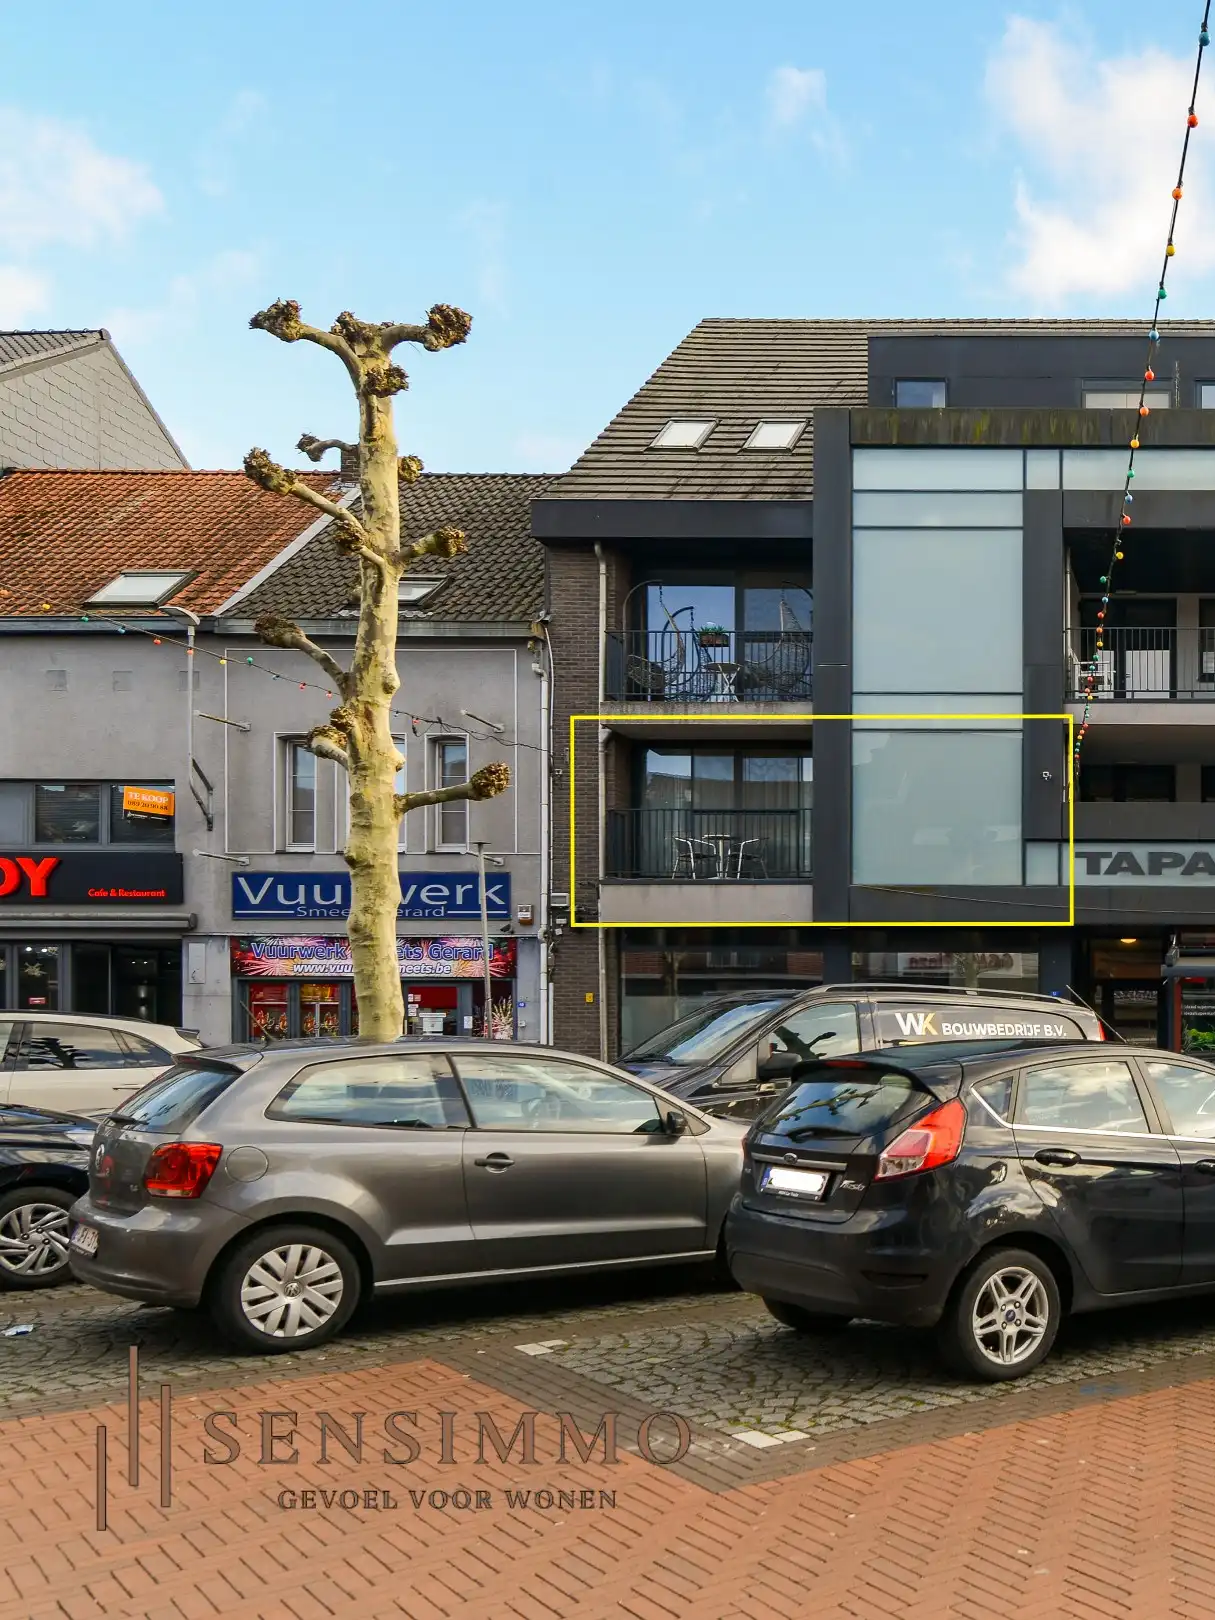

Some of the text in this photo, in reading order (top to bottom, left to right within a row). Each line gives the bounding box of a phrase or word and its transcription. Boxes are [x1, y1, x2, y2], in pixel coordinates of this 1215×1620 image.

[128, 792, 169, 803] TE KOOP
[88, 888, 166, 897] Cafe & Restaurant
[397, 906, 445, 917] erard
[251, 942, 348, 960] Vuurwerk
[895, 1012, 1067, 1037] WK BOUWBEDRIJF B.V.
